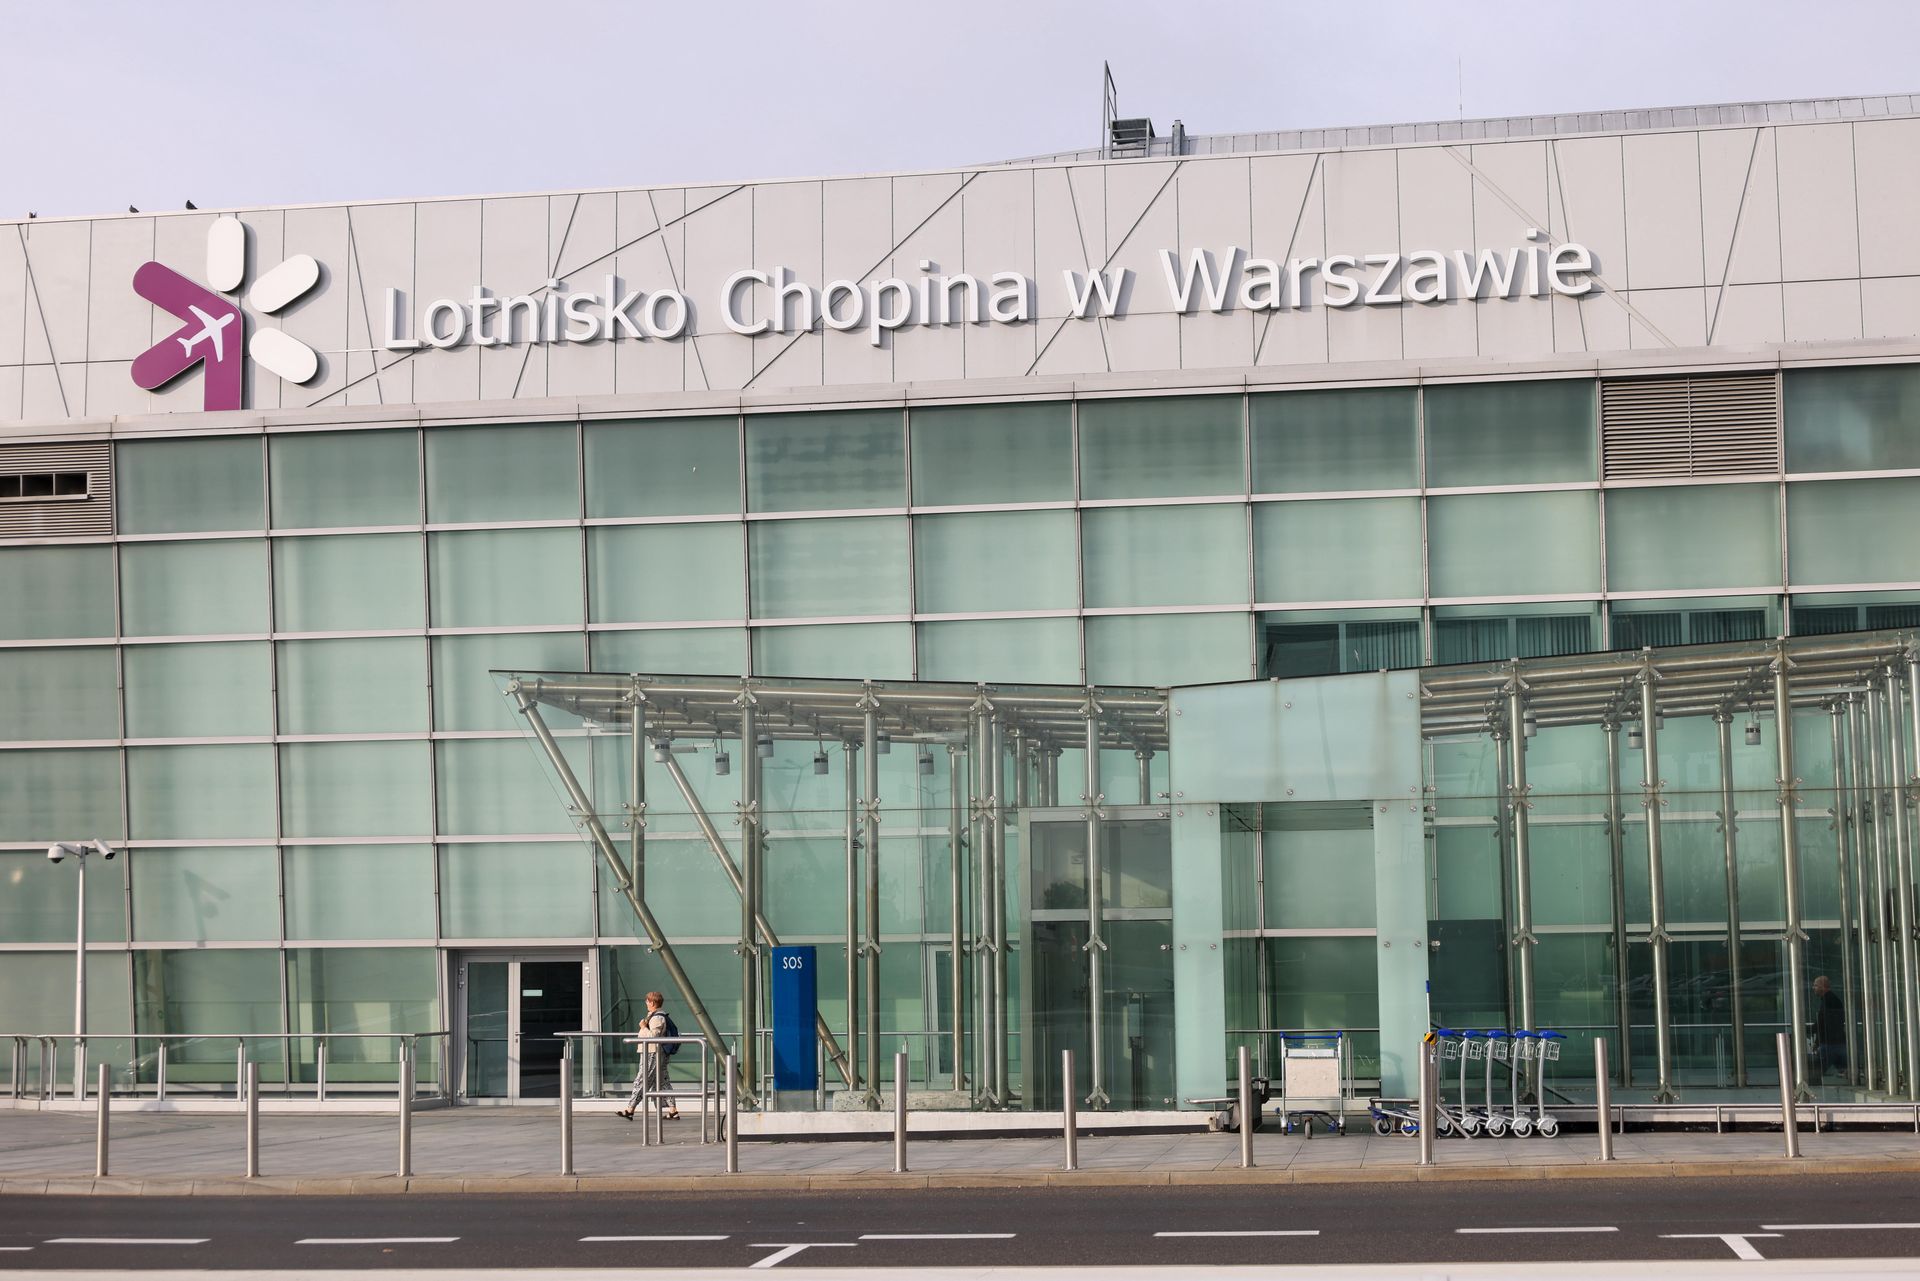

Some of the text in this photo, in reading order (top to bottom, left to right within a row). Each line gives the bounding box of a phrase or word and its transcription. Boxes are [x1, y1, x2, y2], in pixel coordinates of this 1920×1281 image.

[384, 228, 1593, 350] Lotnisko Chopina w Warszawie
[782, 956, 803, 969] SOS
